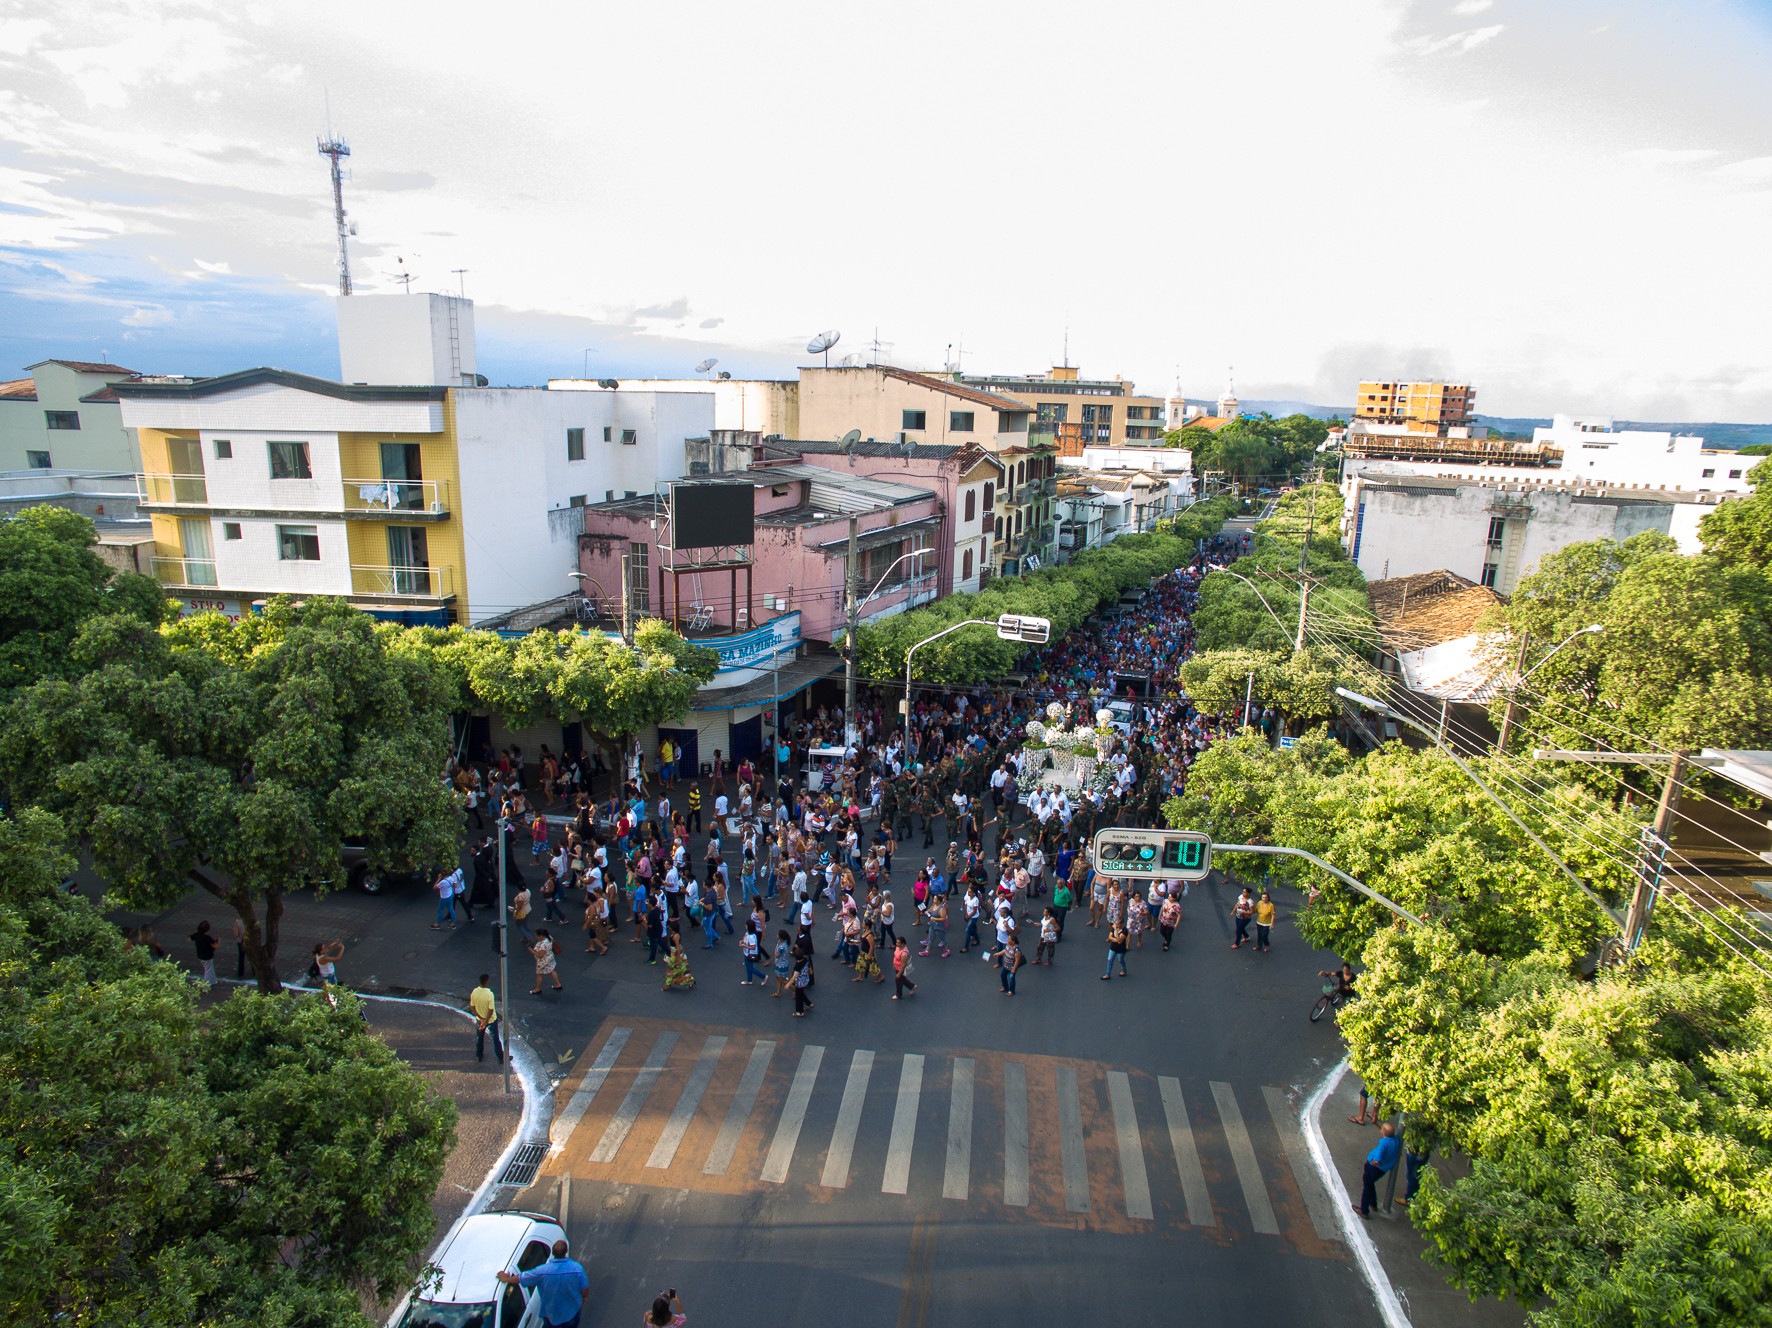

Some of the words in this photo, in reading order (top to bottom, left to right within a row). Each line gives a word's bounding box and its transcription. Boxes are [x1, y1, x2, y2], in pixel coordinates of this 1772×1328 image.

[739, 633, 782, 658] MAZINHO
[1102, 861, 1125, 870] SIGA
[1177, 841, 1201, 867] 10
